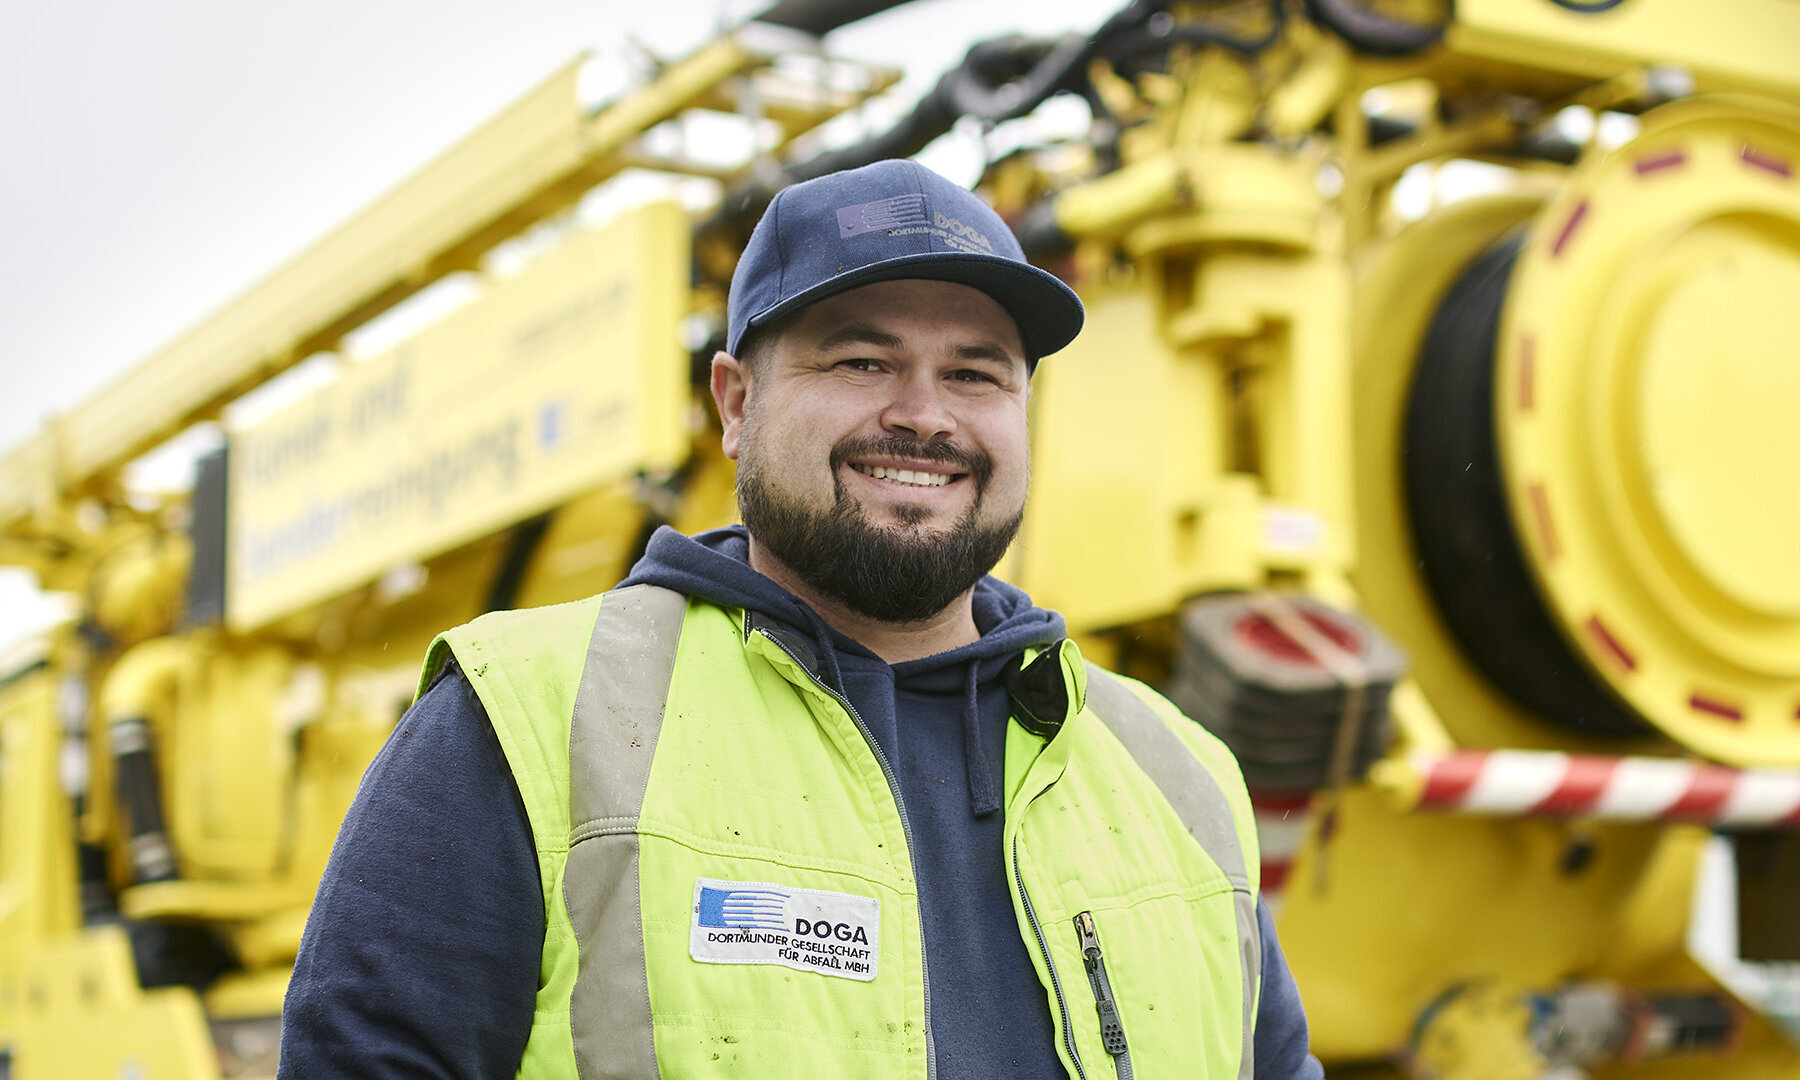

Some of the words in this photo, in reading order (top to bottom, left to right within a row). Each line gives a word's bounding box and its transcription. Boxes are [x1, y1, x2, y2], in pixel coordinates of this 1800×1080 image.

[934, 211, 993, 250] DOGA
[795, 918, 868, 945] DOGA
[708, 932, 789, 946] DORTMUNDER
[791, 938, 870, 960] GESELLSCHAFT
[778, 946, 798, 962] FÜR
[802, 954, 842, 970] ABFALL
[844, 961, 870, 974] MBH
